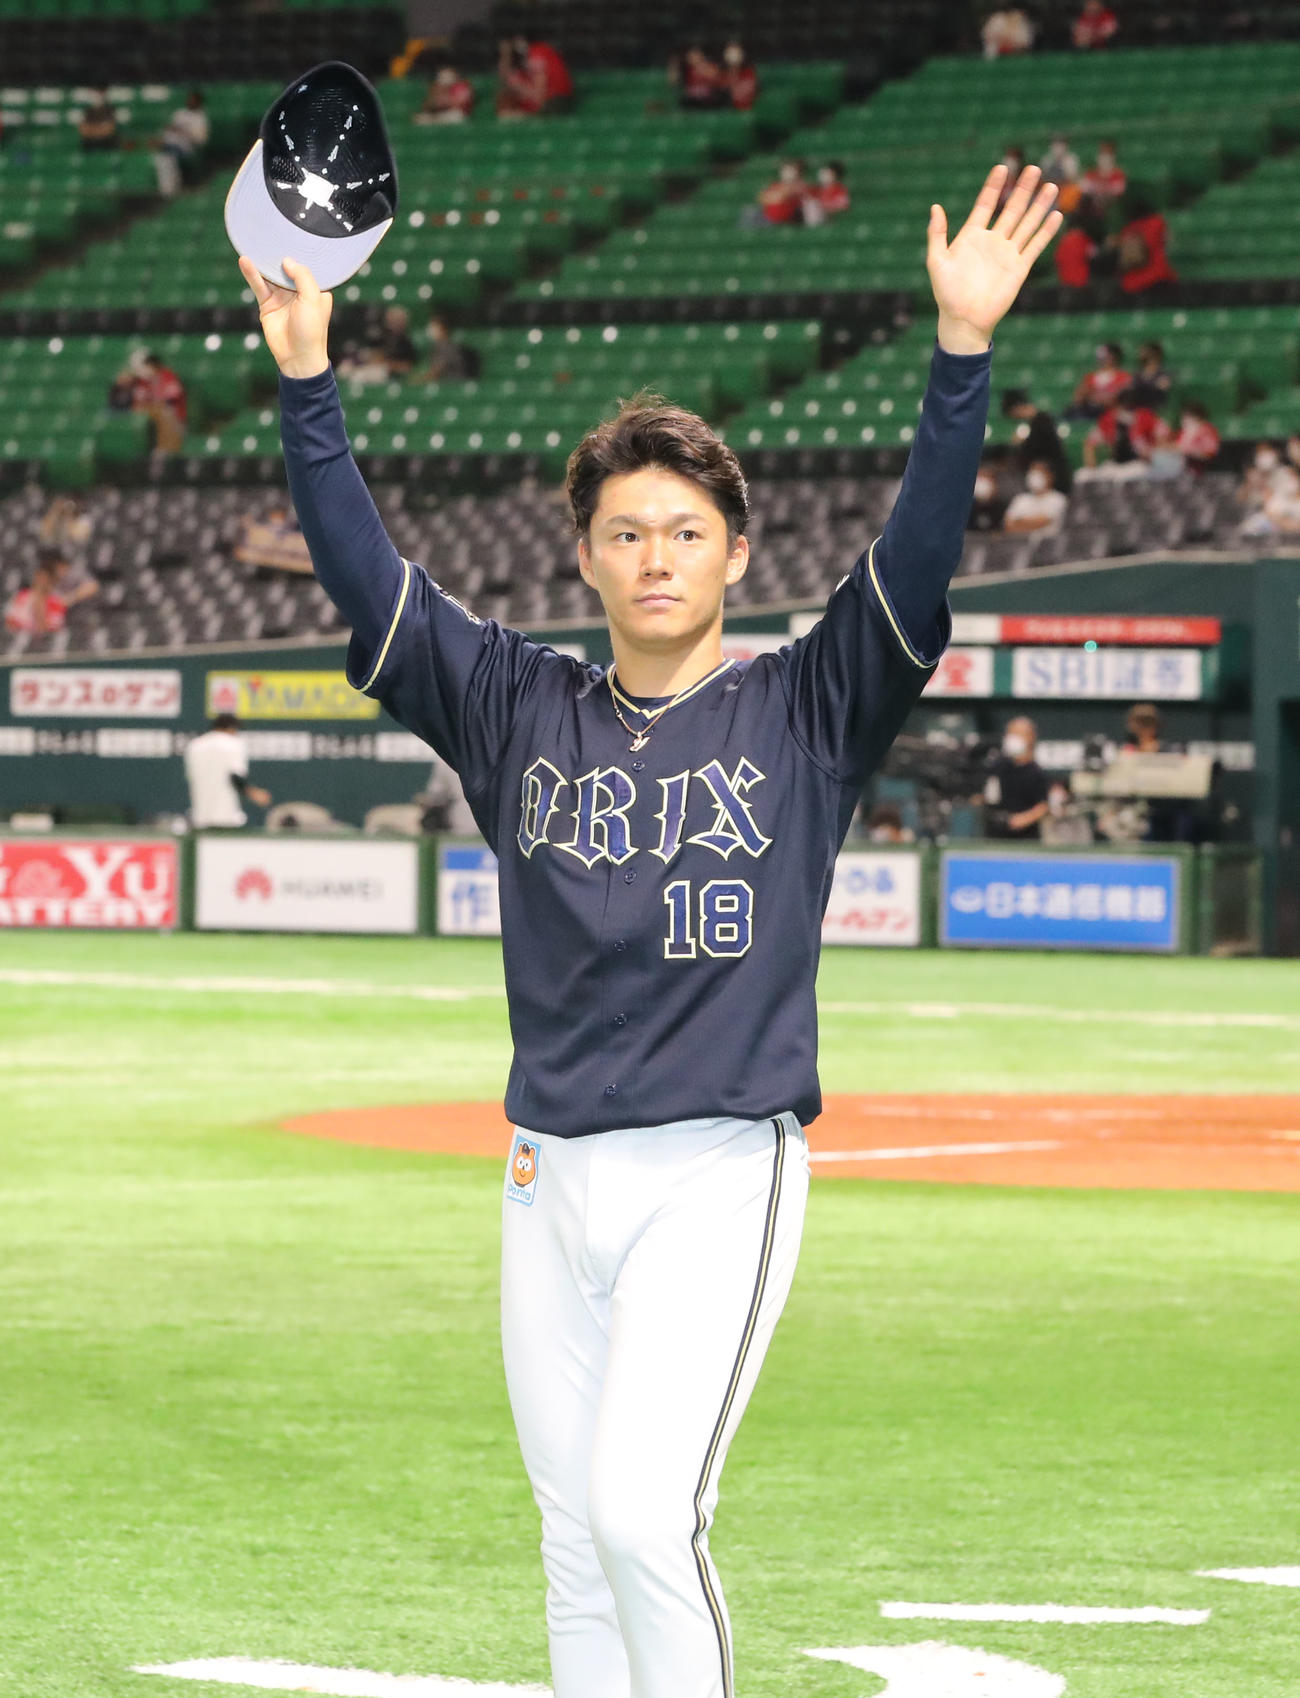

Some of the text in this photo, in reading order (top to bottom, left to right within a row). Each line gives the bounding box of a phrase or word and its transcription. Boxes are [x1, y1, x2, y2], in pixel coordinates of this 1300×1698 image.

[1025, 655, 1184, 690] SBI証券
[517, 756, 773, 870] ORIX
[281, 879, 384, 901] HUAWEI
[663, 879, 754, 959] 18
